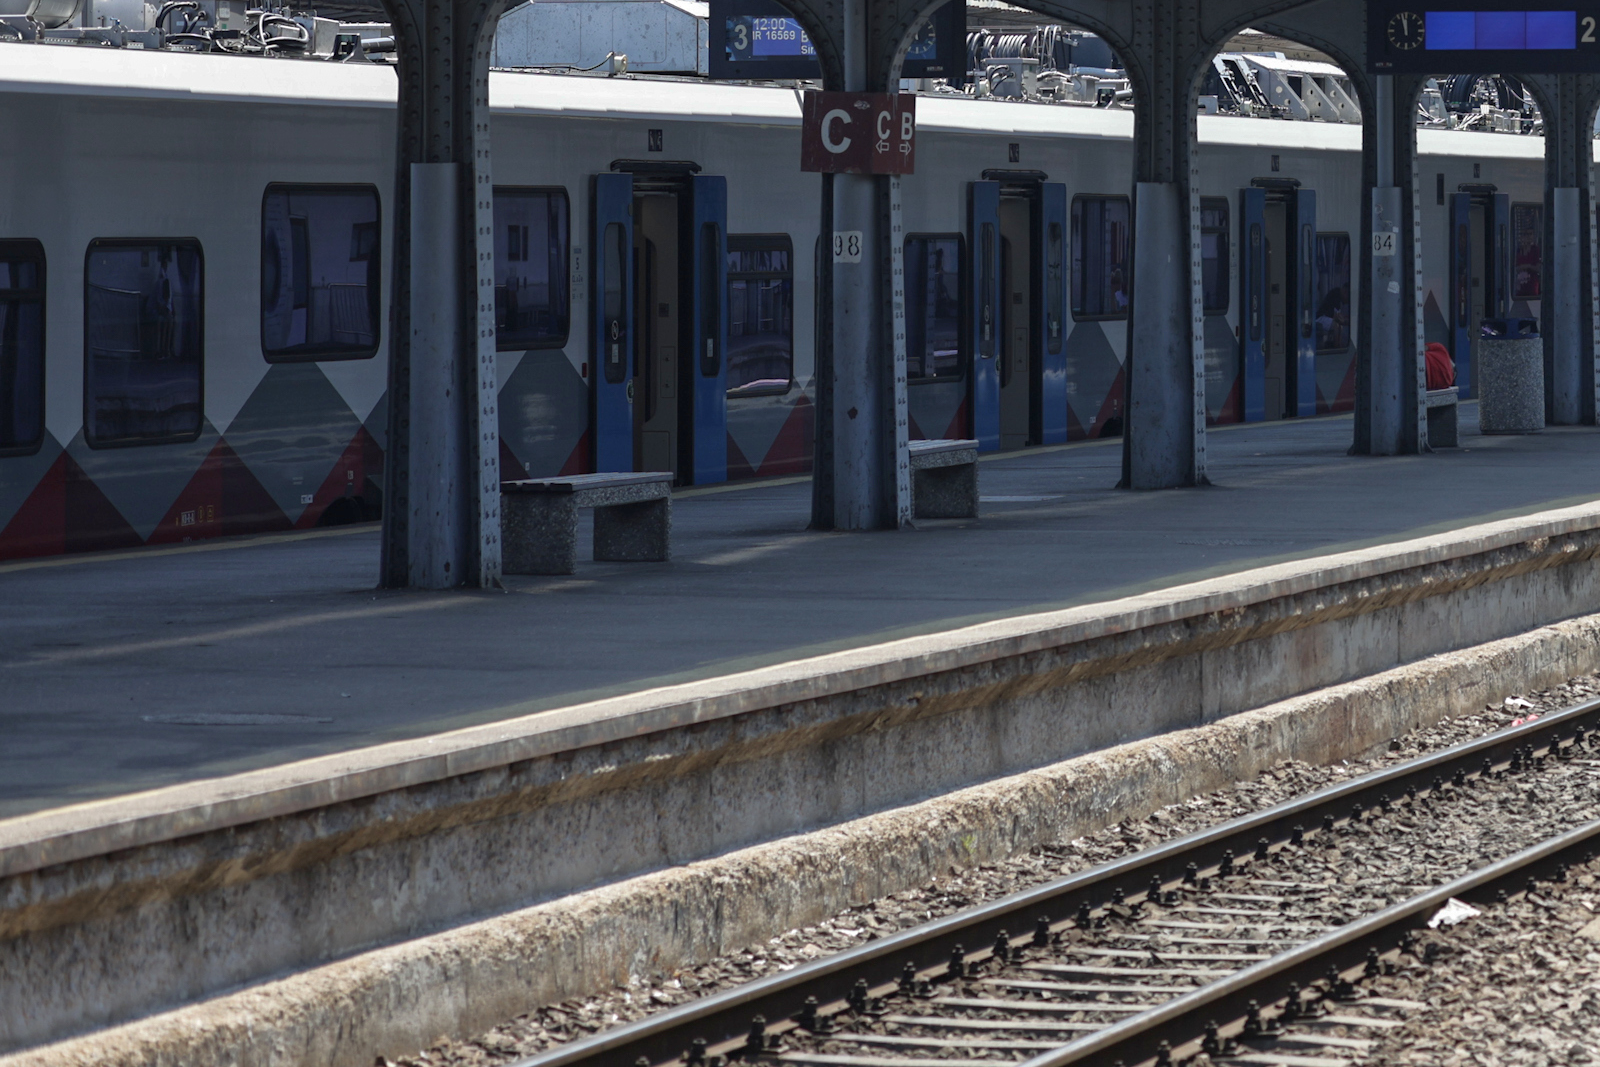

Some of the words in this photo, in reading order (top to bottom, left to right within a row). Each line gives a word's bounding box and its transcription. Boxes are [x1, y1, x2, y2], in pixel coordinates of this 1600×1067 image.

[752, 30, 762, 40] IR
[766, 30, 796, 40] 16569
[753, 18, 786, 30] 12:00
[1581, 16, 1596, 43] 2
[734, 24, 748, 51] 3
[821, 109, 852, 154] C
[877, 110, 891, 140] C
[901, 111, 913, 141] B
[834, 234, 861, 257] 98
[1373, 234, 1393, 251] 84
